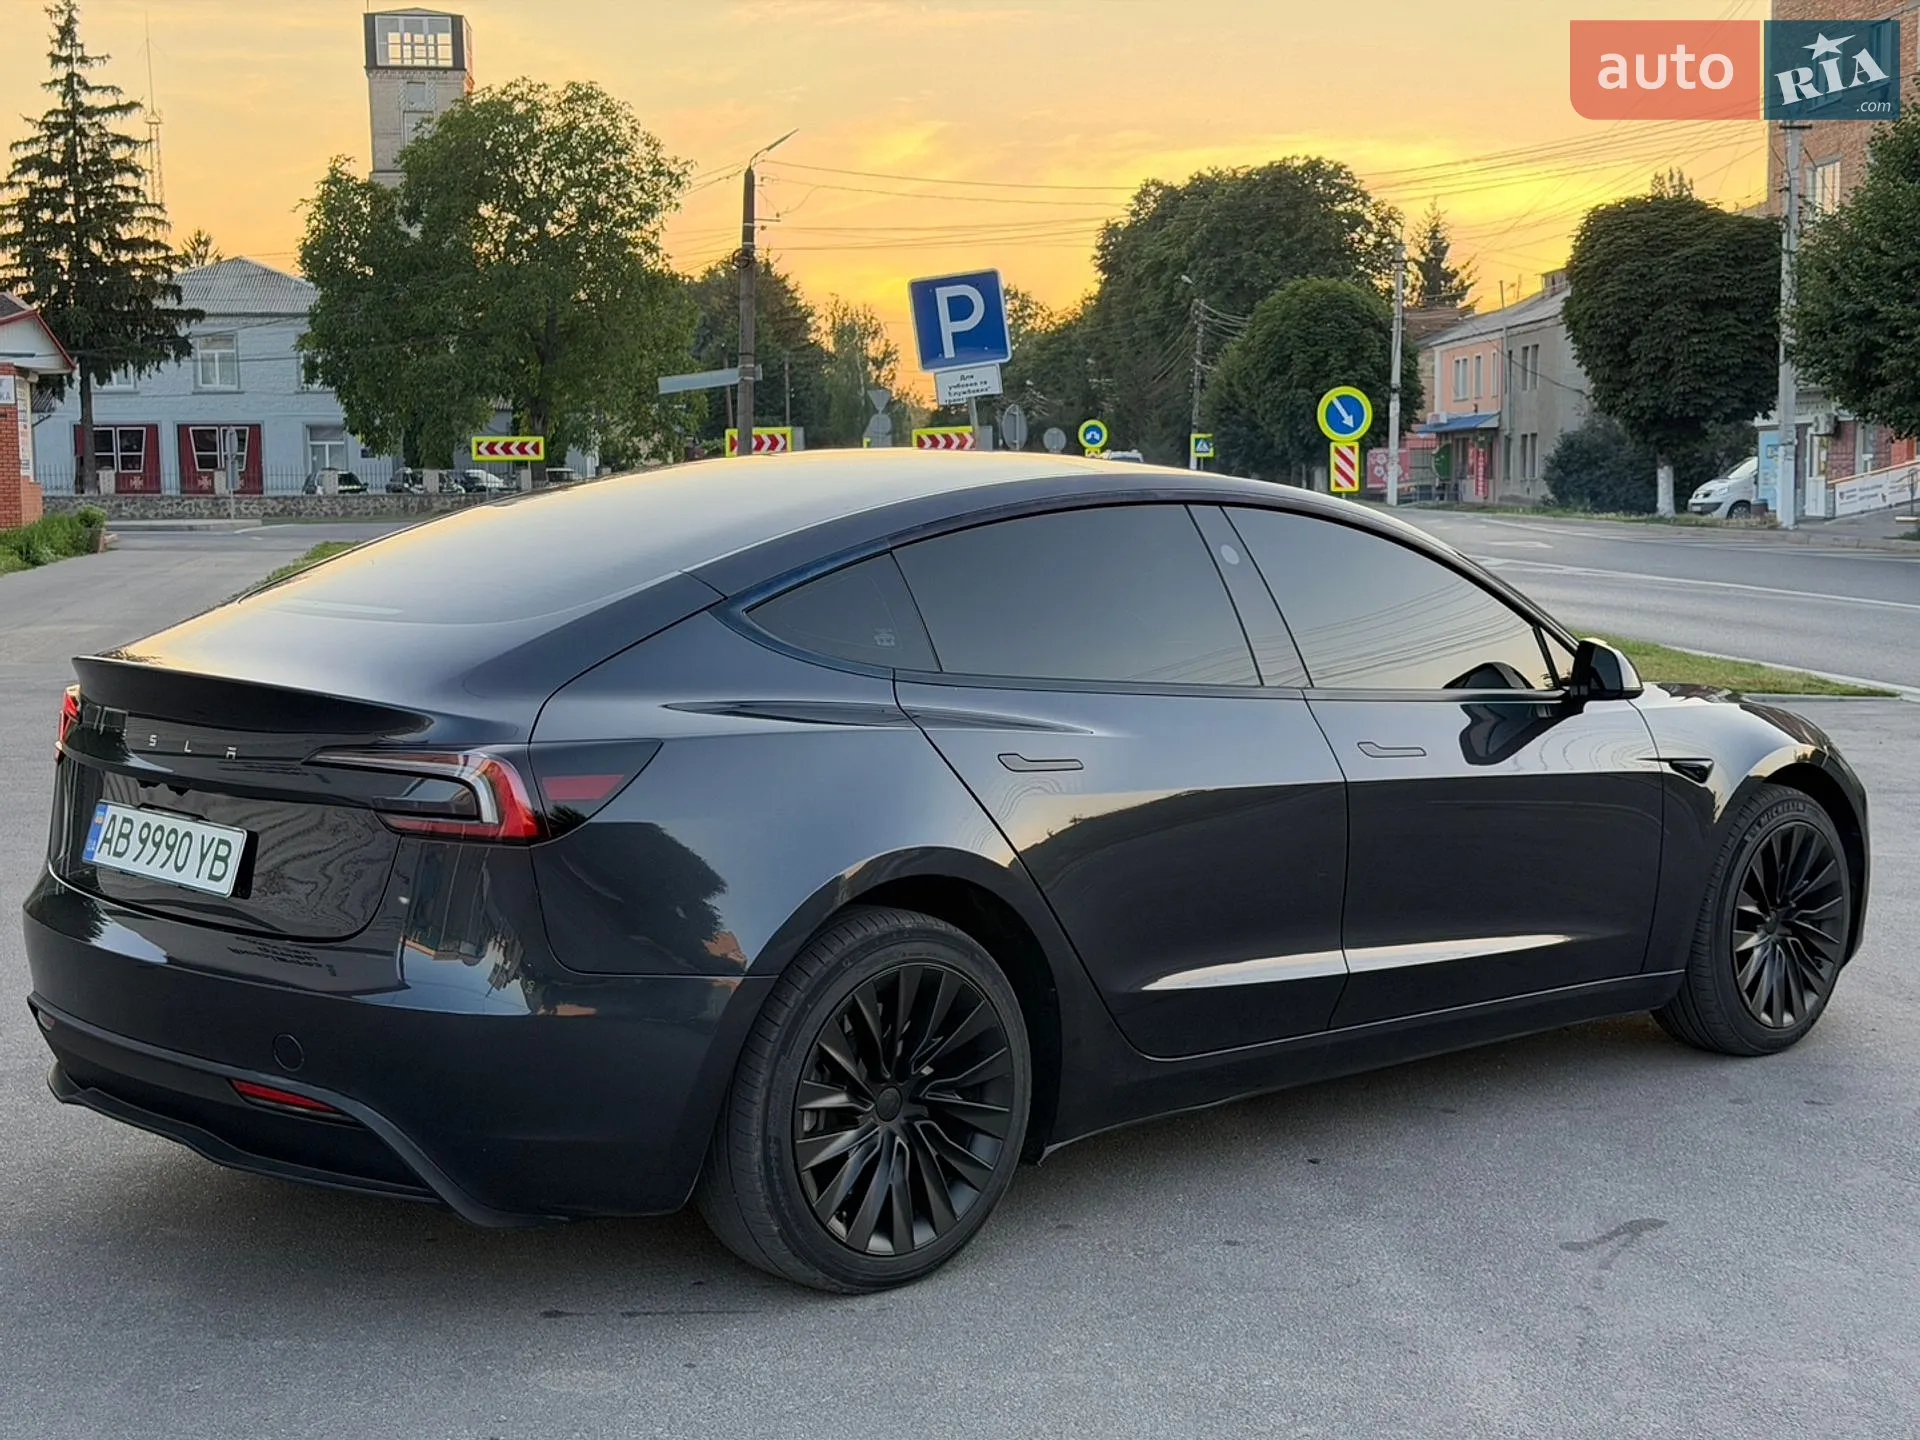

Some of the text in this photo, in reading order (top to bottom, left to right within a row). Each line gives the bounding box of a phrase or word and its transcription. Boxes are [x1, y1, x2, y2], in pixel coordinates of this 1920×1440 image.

[935, 284, 985, 359] P
[98, 814, 232, 882] AB 9990 YB
